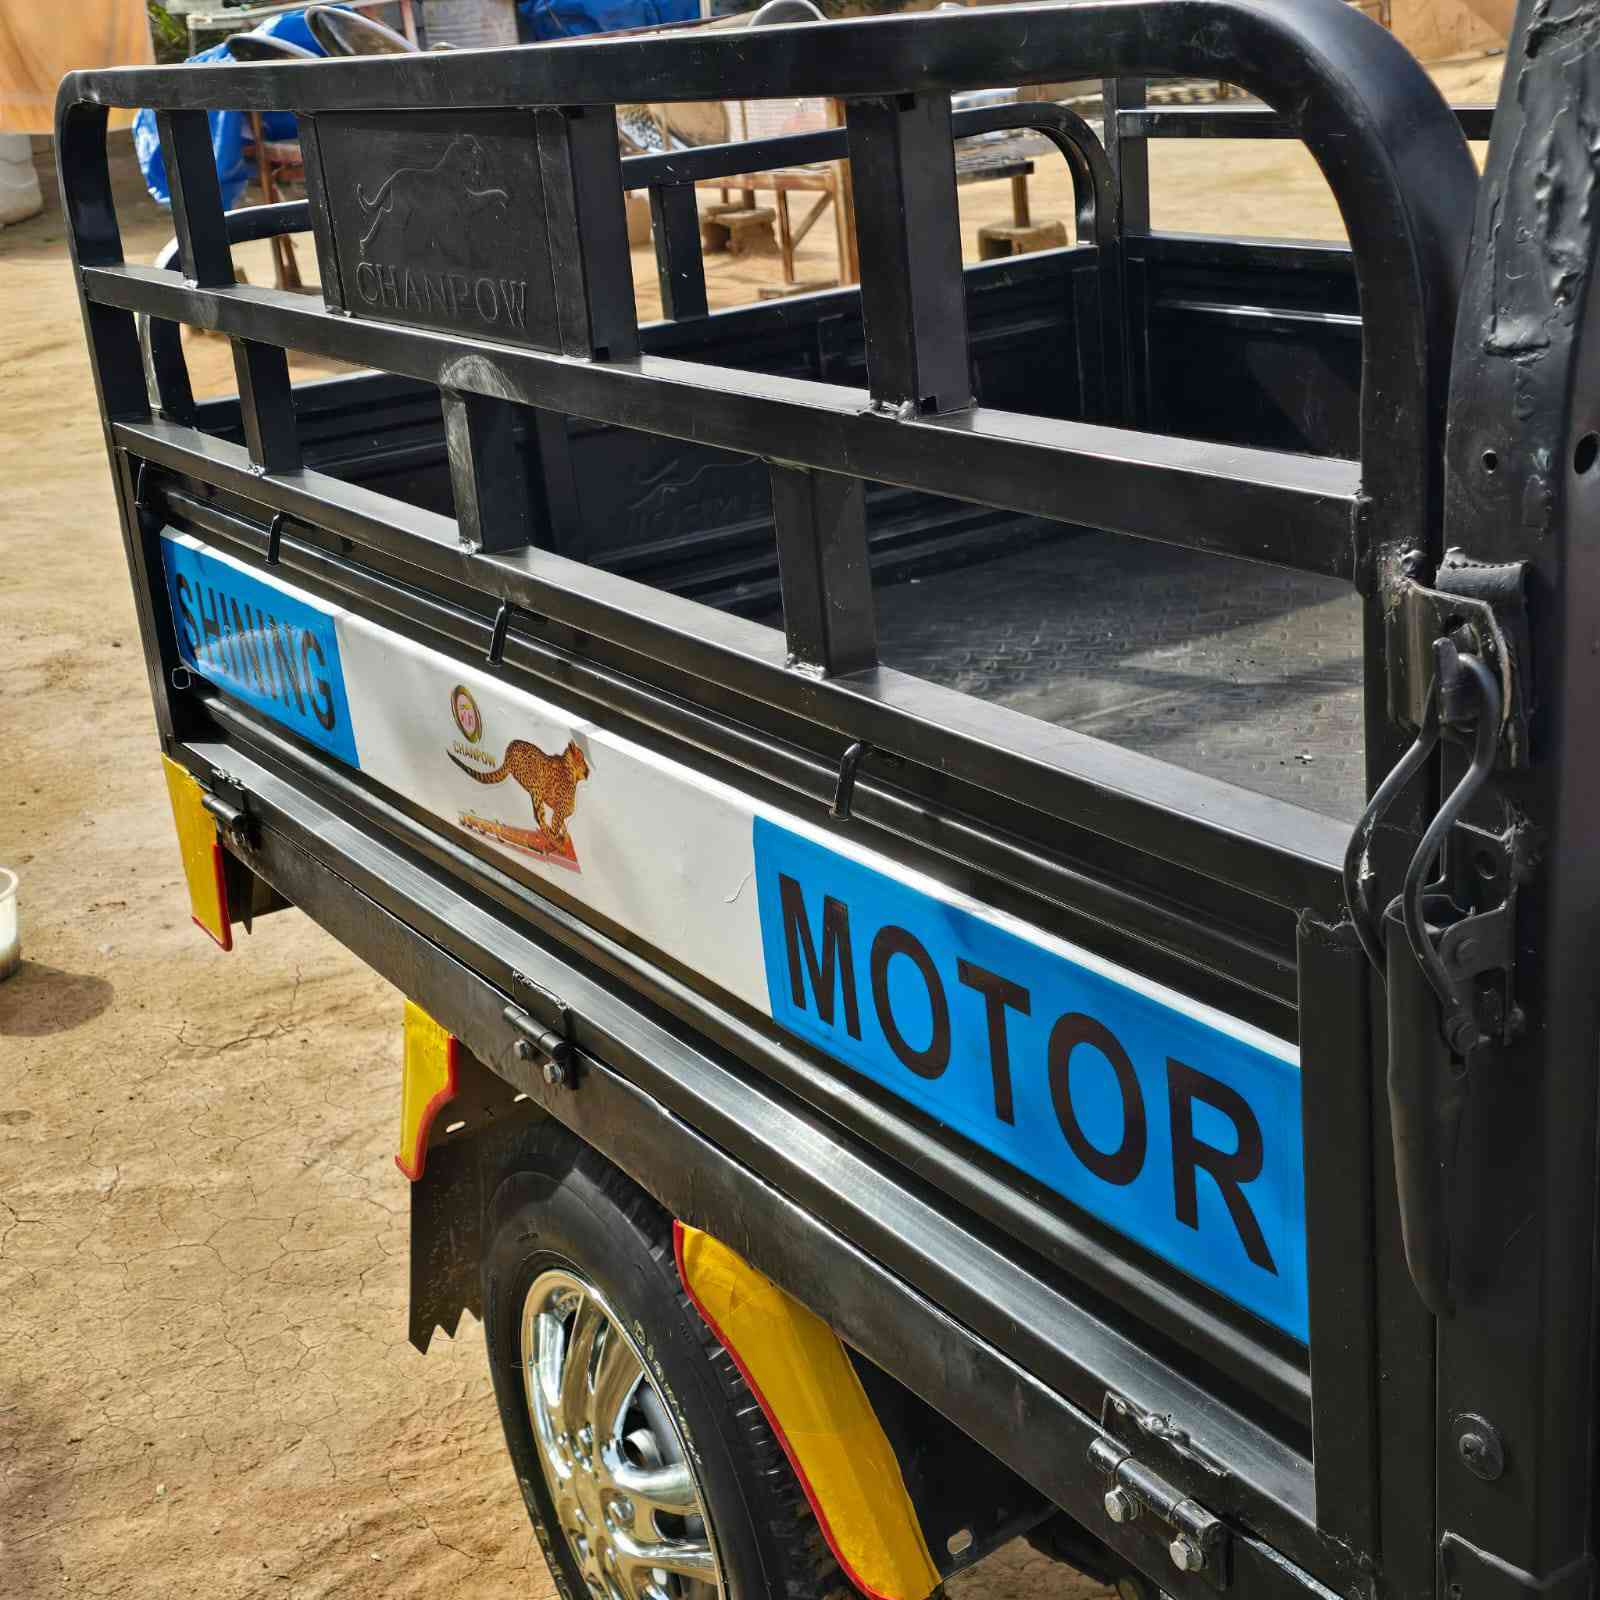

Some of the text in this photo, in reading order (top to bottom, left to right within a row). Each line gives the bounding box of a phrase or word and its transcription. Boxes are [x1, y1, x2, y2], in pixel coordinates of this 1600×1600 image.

[356, 262, 528, 328] CHANPOW
[176, 573, 1279, 1277] SHINING MOTOR
